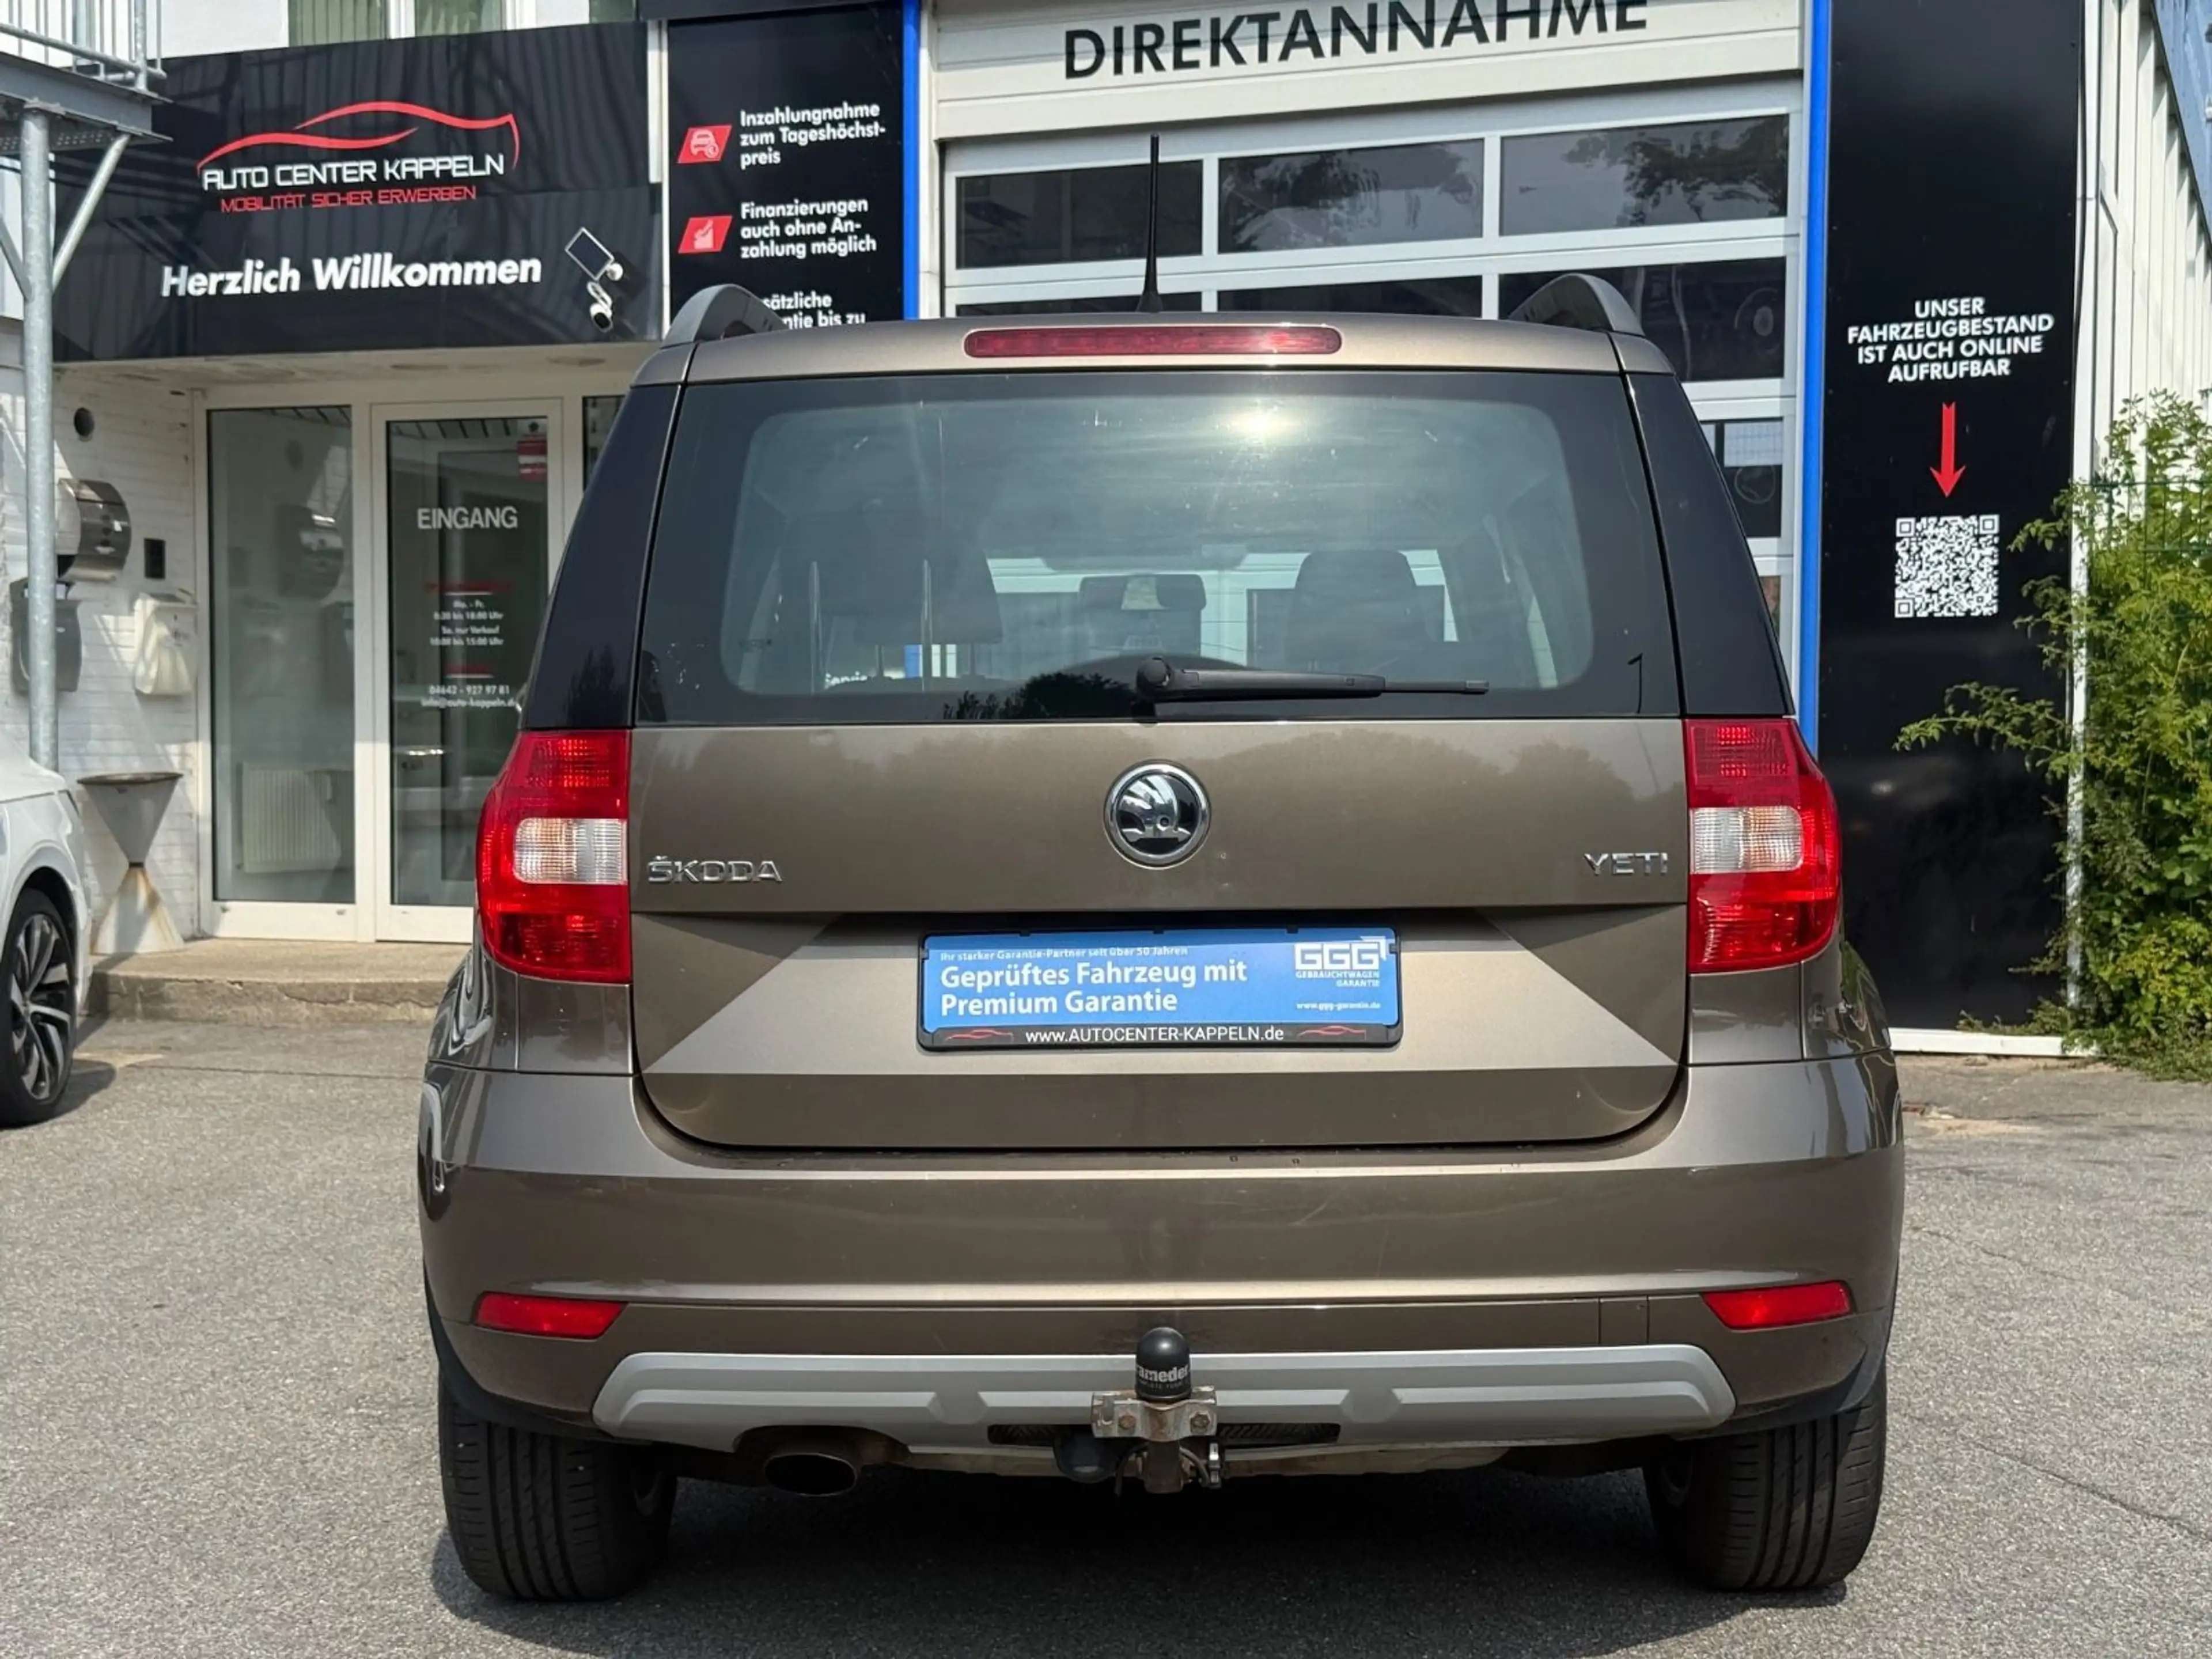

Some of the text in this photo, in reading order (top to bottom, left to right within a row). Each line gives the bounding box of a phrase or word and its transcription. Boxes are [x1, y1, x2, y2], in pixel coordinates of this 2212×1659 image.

[1065, 0, 1647, 80] DIREKTANNAHME
[740, 100, 880, 127] Inzahlungnahme
[740, 120, 886, 146] zum Tageshöchst-
[740, 147, 781, 169] preis
[203, 153, 505, 192] AUTO CENTER KAPPELN
[220, 185, 477, 213] MOBILITÄT SICHER ERWERBEN
[741, 198, 868, 219] Finanzierungen
[741, 218, 862, 239] auch ohne An-
[741, 234, 877, 260] zahlung möglich
[161, 252, 543, 297] Herzlich Willkommen
[763, 290, 832, 310] sätzliche
[1914, 297, 1986, 318] UNSER
[817, 310, 842, 327] bis
[846, 313, 866, 324] zu
[1847, 314, 2055, 344] FAHRZEUGBESTAND
[1857, 335, 2043, 364] IST AUCH ONLINE
[1887, 358, 2012, 383] AUFRUFBAR
[416, 506, 518, 529] EINGANG
[648, 855, 782, 882] ŠKODA
[1584, 852, 1669, 876] YETI
[941, 945, 1188, 961] Ihr starker Garantie-Partner seit über 50 Jahren
[1294, 942, 1380, 969] GGG
[941, 959, 1248, 992] Geprüftes Fahrzeug mit
[1295, 971, 1380, 979] GEBRAUCHTWAGEN
[1336, 979, 1380, 987] GARANTIE
[941, 988, 1178, 1017] Premium Garantie
[1025, 1025, 1284, 1043] www.AUTOCENTER-KAPPELN.de
